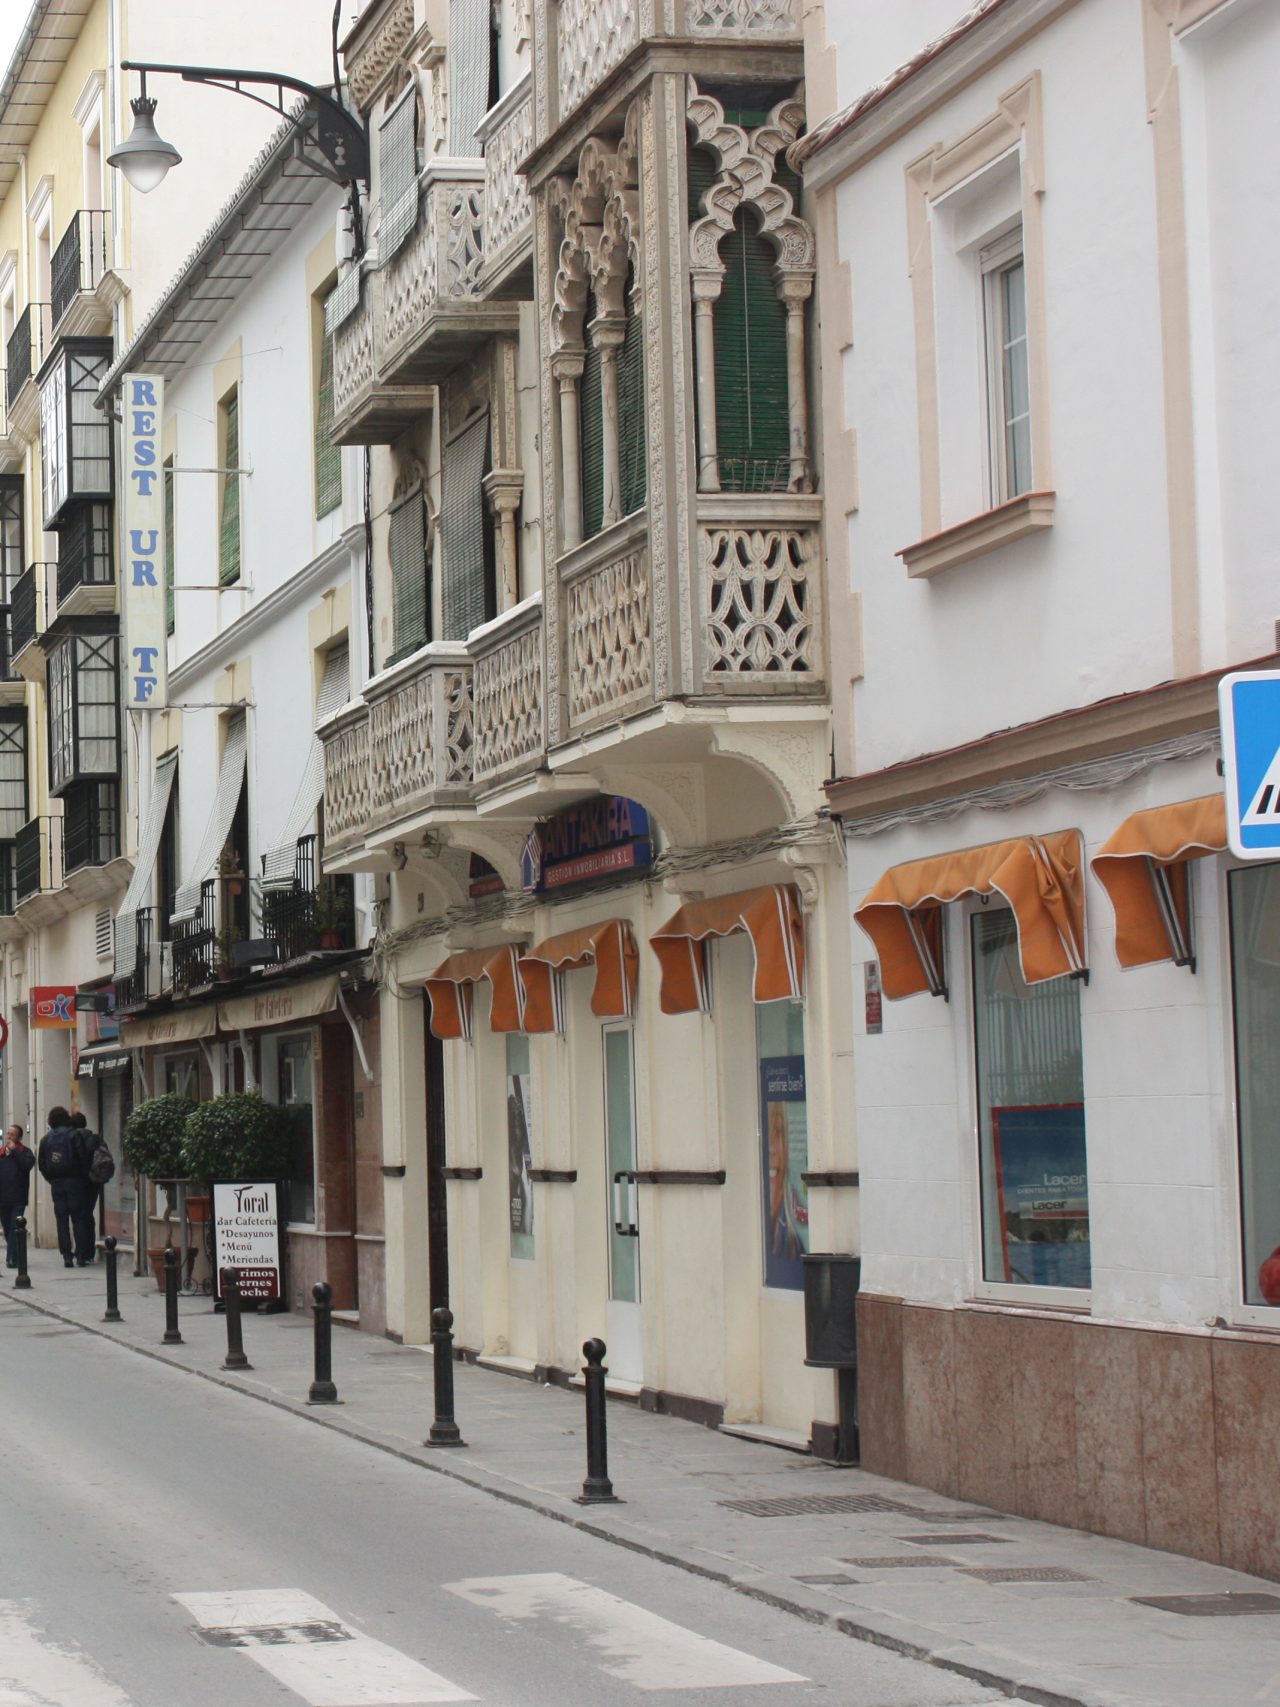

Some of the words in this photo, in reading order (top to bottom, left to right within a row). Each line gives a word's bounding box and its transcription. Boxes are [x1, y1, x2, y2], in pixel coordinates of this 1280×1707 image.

[1043, 1173, 1086, 1186] Lacer
[233, 1185, 269, 1213] Toral
[1032, 1201, 1067, 1210] Lacer
[235, 1216, 277, 1226] Cafetería
[240, 1269, 275, 1278] rimos
[236, 1279, 272, 1287] ernes
[240, 1288, 270, 1297] oche
